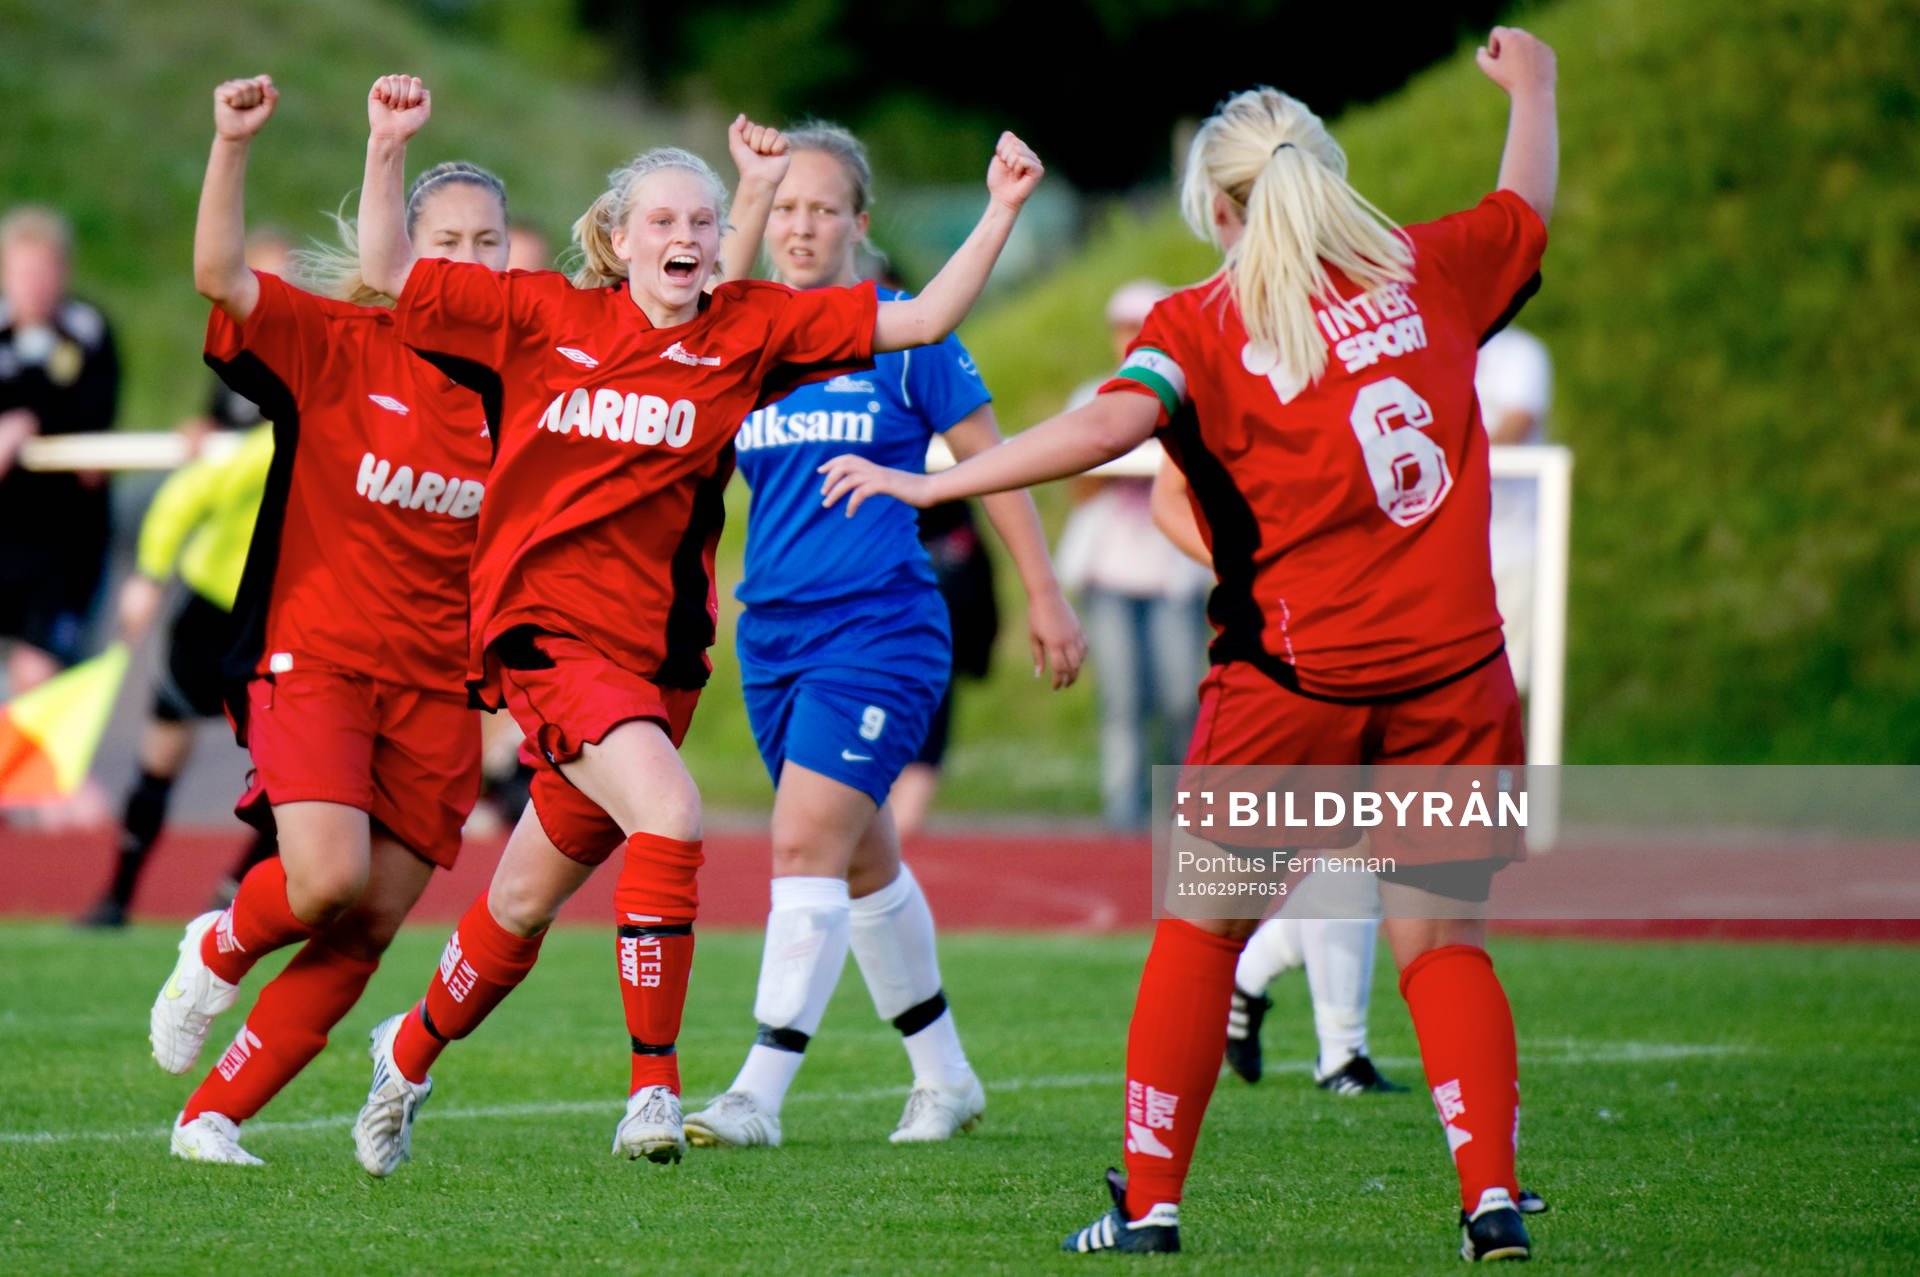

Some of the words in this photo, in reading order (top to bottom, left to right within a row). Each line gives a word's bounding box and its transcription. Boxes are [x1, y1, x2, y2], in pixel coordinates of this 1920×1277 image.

[1318, 283, 1418, 341] INTER
[1336, 314, 1428, 374] SPORT
[735, 403, 873, 451] olksam
[1350, 376, 1453, 528] 6
[356, 452, 486, 519] HARIB
[859, 705, 886, 740] 9
[447, 959, 478, 1003] NTER
[620, 936, 639, 987] PORT
[639, 936, 662, 988] NTER
